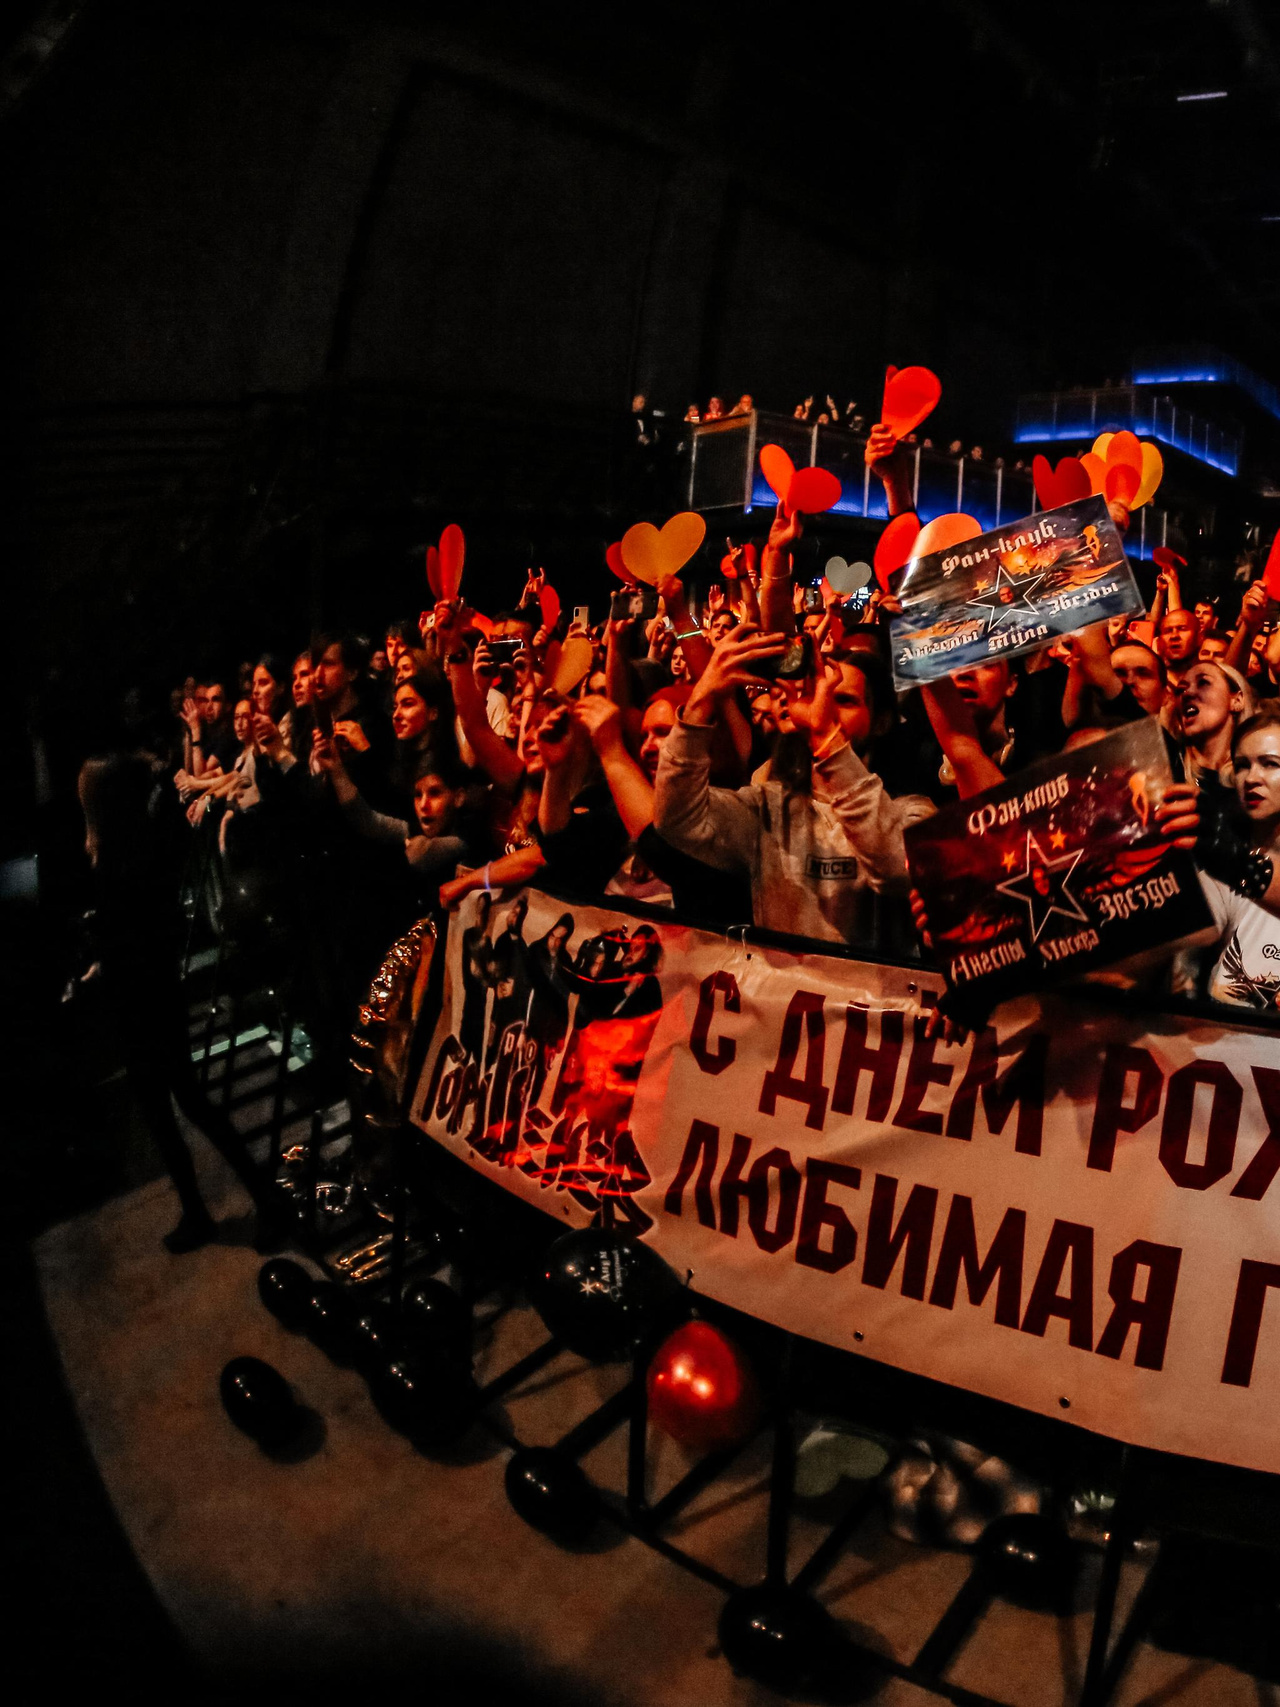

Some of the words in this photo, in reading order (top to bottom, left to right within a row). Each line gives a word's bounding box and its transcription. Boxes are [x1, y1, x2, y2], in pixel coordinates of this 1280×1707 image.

[941, 519, 1056, 577] Фан-клуб
[689, 969, 742, 1076] С
[664, 1118, 1182, 1371] ЛЮБИМАЯ
